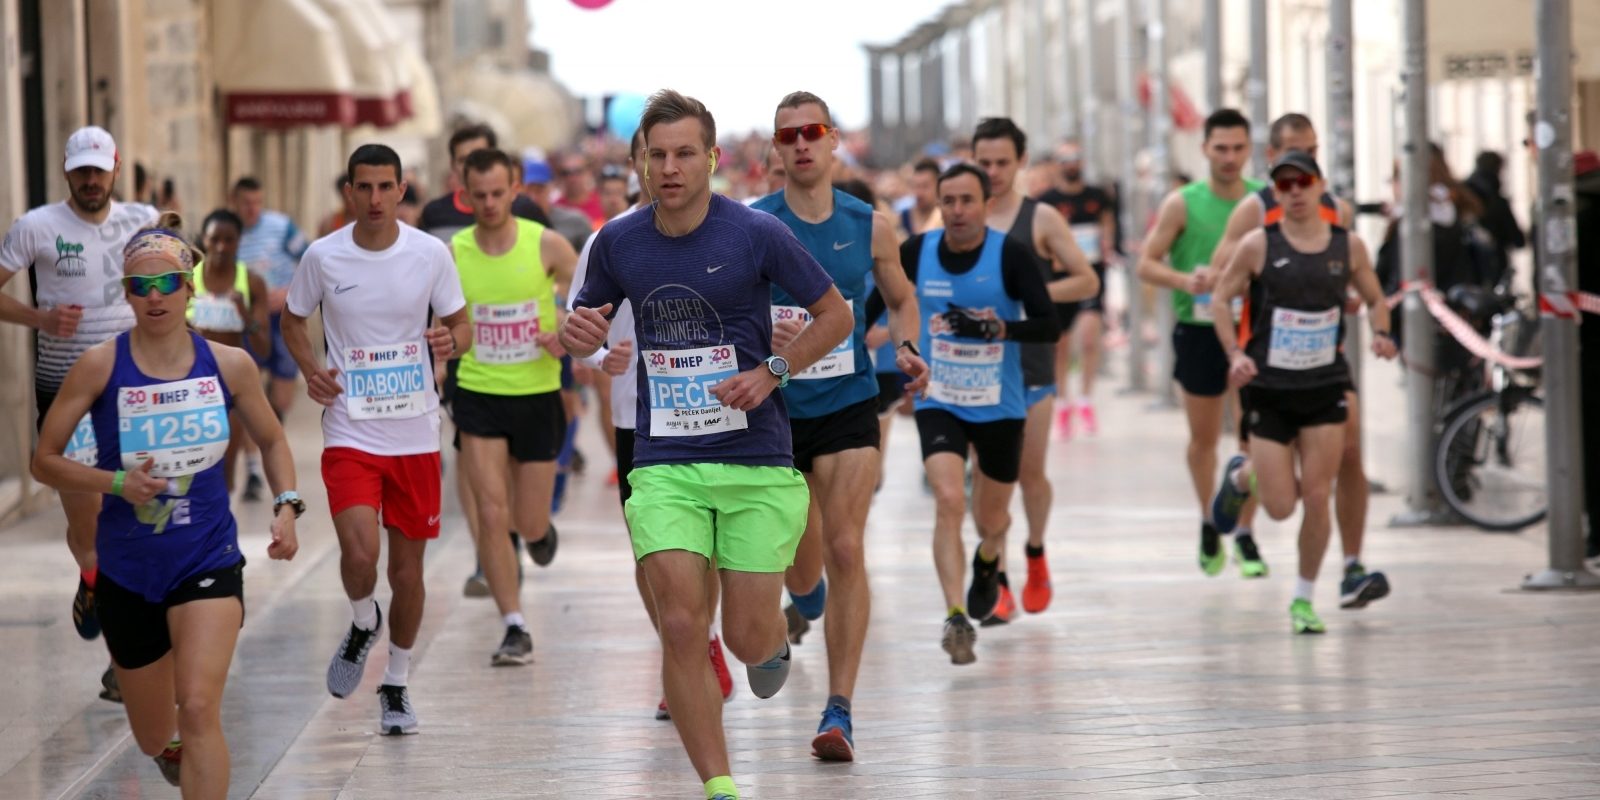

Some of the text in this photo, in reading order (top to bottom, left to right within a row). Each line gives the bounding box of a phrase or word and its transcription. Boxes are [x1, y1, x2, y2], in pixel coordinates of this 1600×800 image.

[777, 308, 793, 319] 20
[351, 350, 365, 361] 20
[379, 350, 398, 361] HEP
[404, 344, 418, 356] 20
[650, 353, 666, 366] 20
[681, 356, 703, 369] HEP
[712, 347, 731, 361] 20
[354, 363, 422, 395] DABOVIĆ
[127, 390, 146, 404] 20
[165, 389, 190, 404] HEP
[197, 380, 216, 396] 20
[658, 376, 724, 408] PEČE
[140, 410, 223, 447] 1255
[704, 417, 722, 427] IAAF
